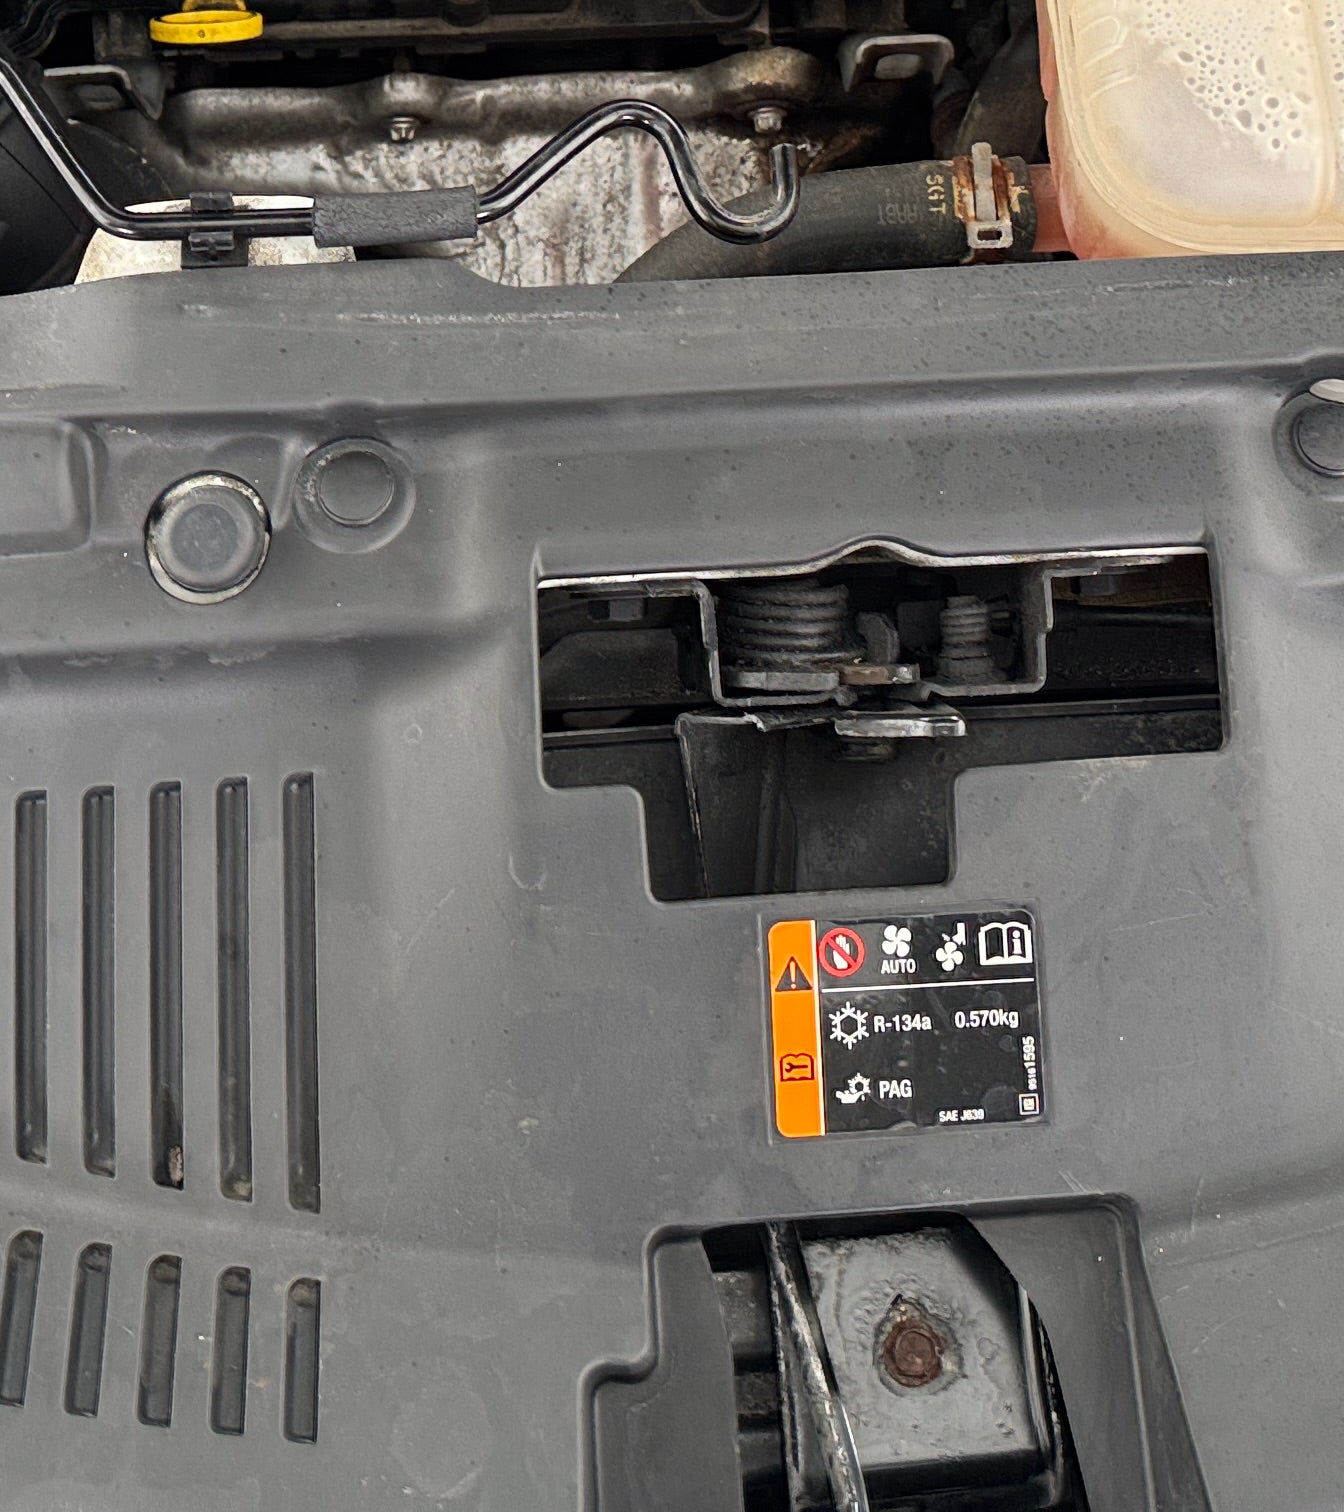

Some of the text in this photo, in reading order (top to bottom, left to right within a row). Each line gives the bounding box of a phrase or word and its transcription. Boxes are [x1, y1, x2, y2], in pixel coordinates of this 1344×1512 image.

[925, 174, 947, 215] SGT
[881, 958, 916, 975] AUTO
[873, 1009, 1019, 1033] R-134a 0.570kg
[878, 1079, 913, 1099] PAG
[938, 1109, 959, 1123] SAE
